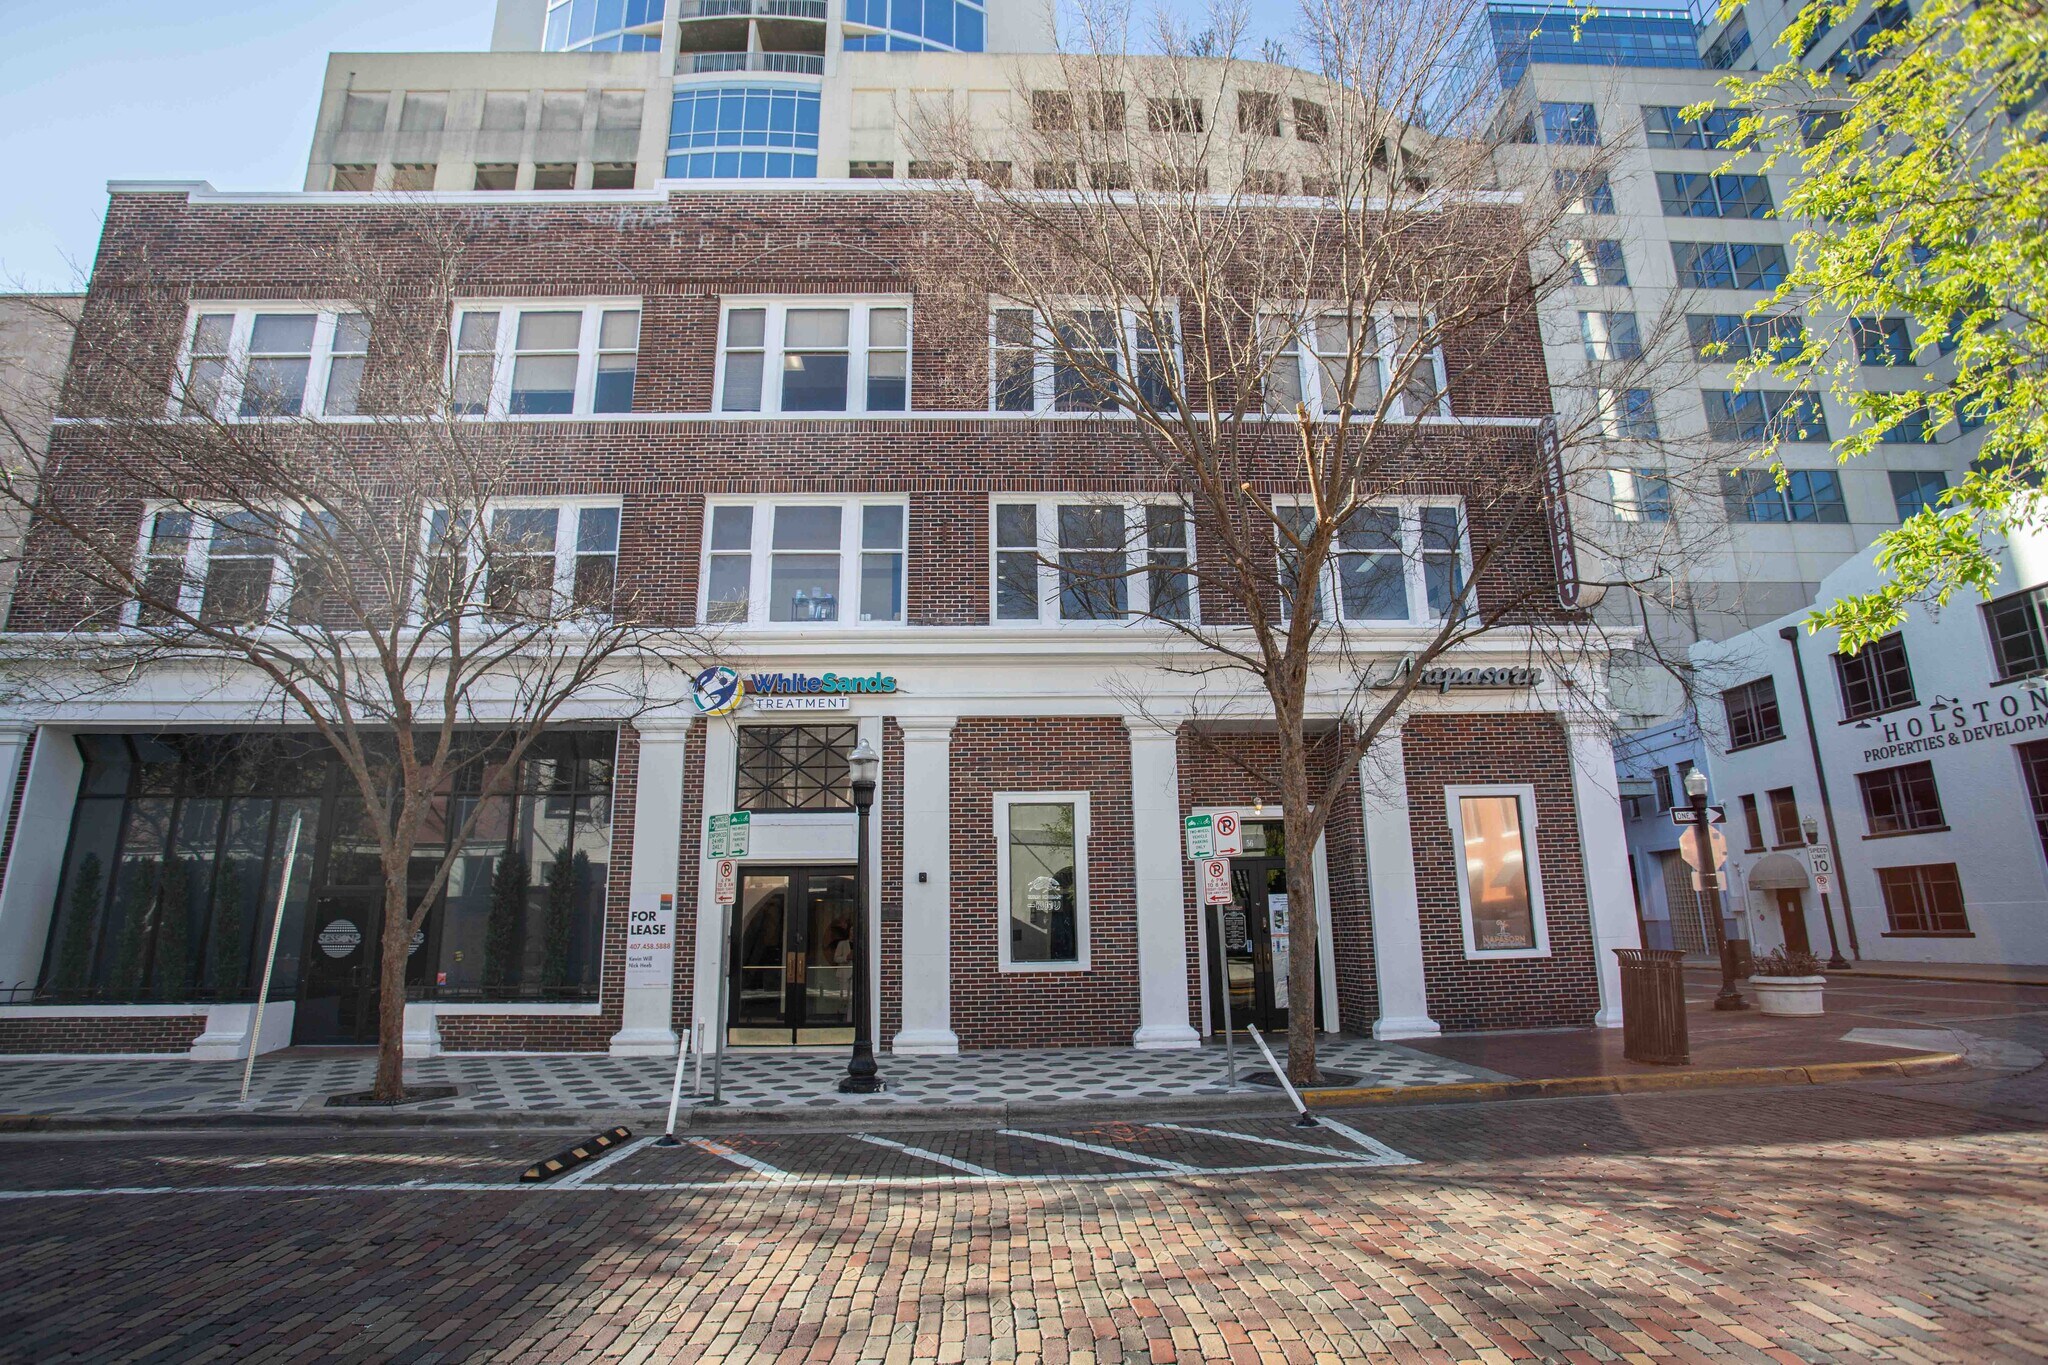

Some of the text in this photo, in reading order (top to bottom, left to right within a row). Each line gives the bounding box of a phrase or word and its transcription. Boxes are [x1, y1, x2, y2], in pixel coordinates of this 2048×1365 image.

[1542, 435, 1575, 599] RESTAURANT
[751, 672, 897, 693] WhiteSands
[757, 697, 848, 709] TREATMENT
[1883, 687, 2048, 743] HOLSTON
[1864, 734, 1945, 763] PROPERTIES
[1948, 732, 1961, 746] &
[1676, 812, 1691, 820] ONE
[1814, 860, 1829, 871] 10
[631, 911, 656, 921] FOR
[630, 925, 666, 935] LEASE
